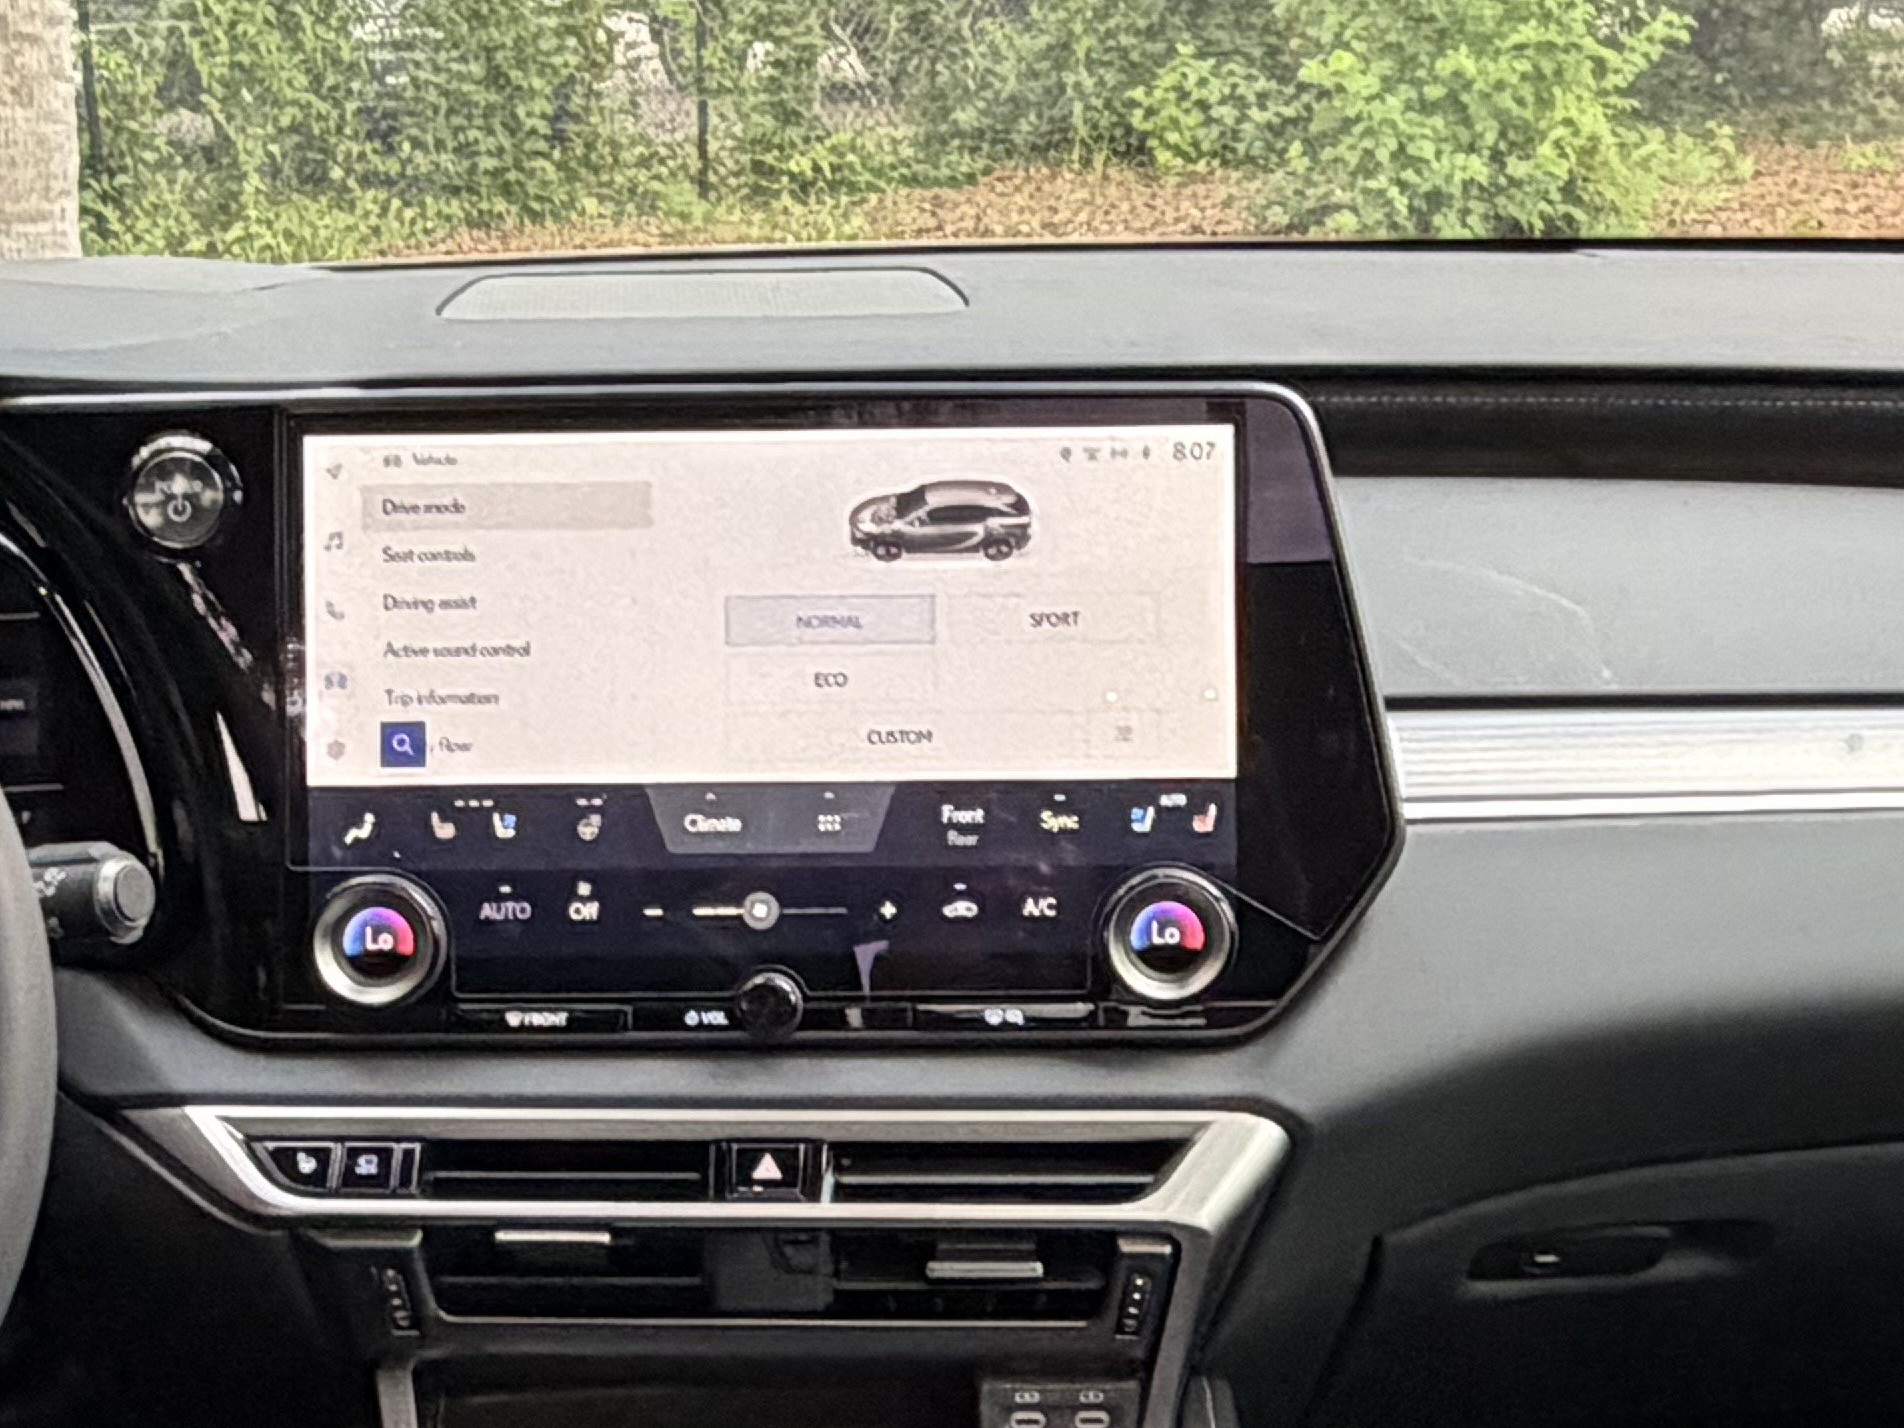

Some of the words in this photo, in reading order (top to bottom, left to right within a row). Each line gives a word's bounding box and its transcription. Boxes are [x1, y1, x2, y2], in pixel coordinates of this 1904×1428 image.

[382, 497, 421, 515] Drive
[423, 496, 466, 514] mode
[382, 544, 414, 563] Seat
[416, 544, 476, 563] controls
[382, 593, 435, 613] Driving
[438, 594, 477, 609] assist
[796, 613, 864, 631] NORMAL
[1028, 610, 1081, 629] SPORT
[382, 640, 430, 658] Active
[432, 641, 477, 658] sound
[479, 640, 531, 658] control
[814, 671, 849, 689] ECO
[384, 688, 414, 709] Trip
[416, 688, 500, 707] information
[865, 729, 934, 747] CUSTOM
[683, 812, 743, 834] Climate
[940, 803, 986, 824] Front
[1040, 809, 1080, 833] Sync
[947, 828, 980, 846] Rear
[479, 901, 533, 921] AUTO
[567, 901, 600, 922] Off
[1022, 896, 1058, 917] A/C
[364, 926, 395, 952] Lo
[1150, 920, 1181, 946] Lo
[700, 1010, 730, 1026] VOL
